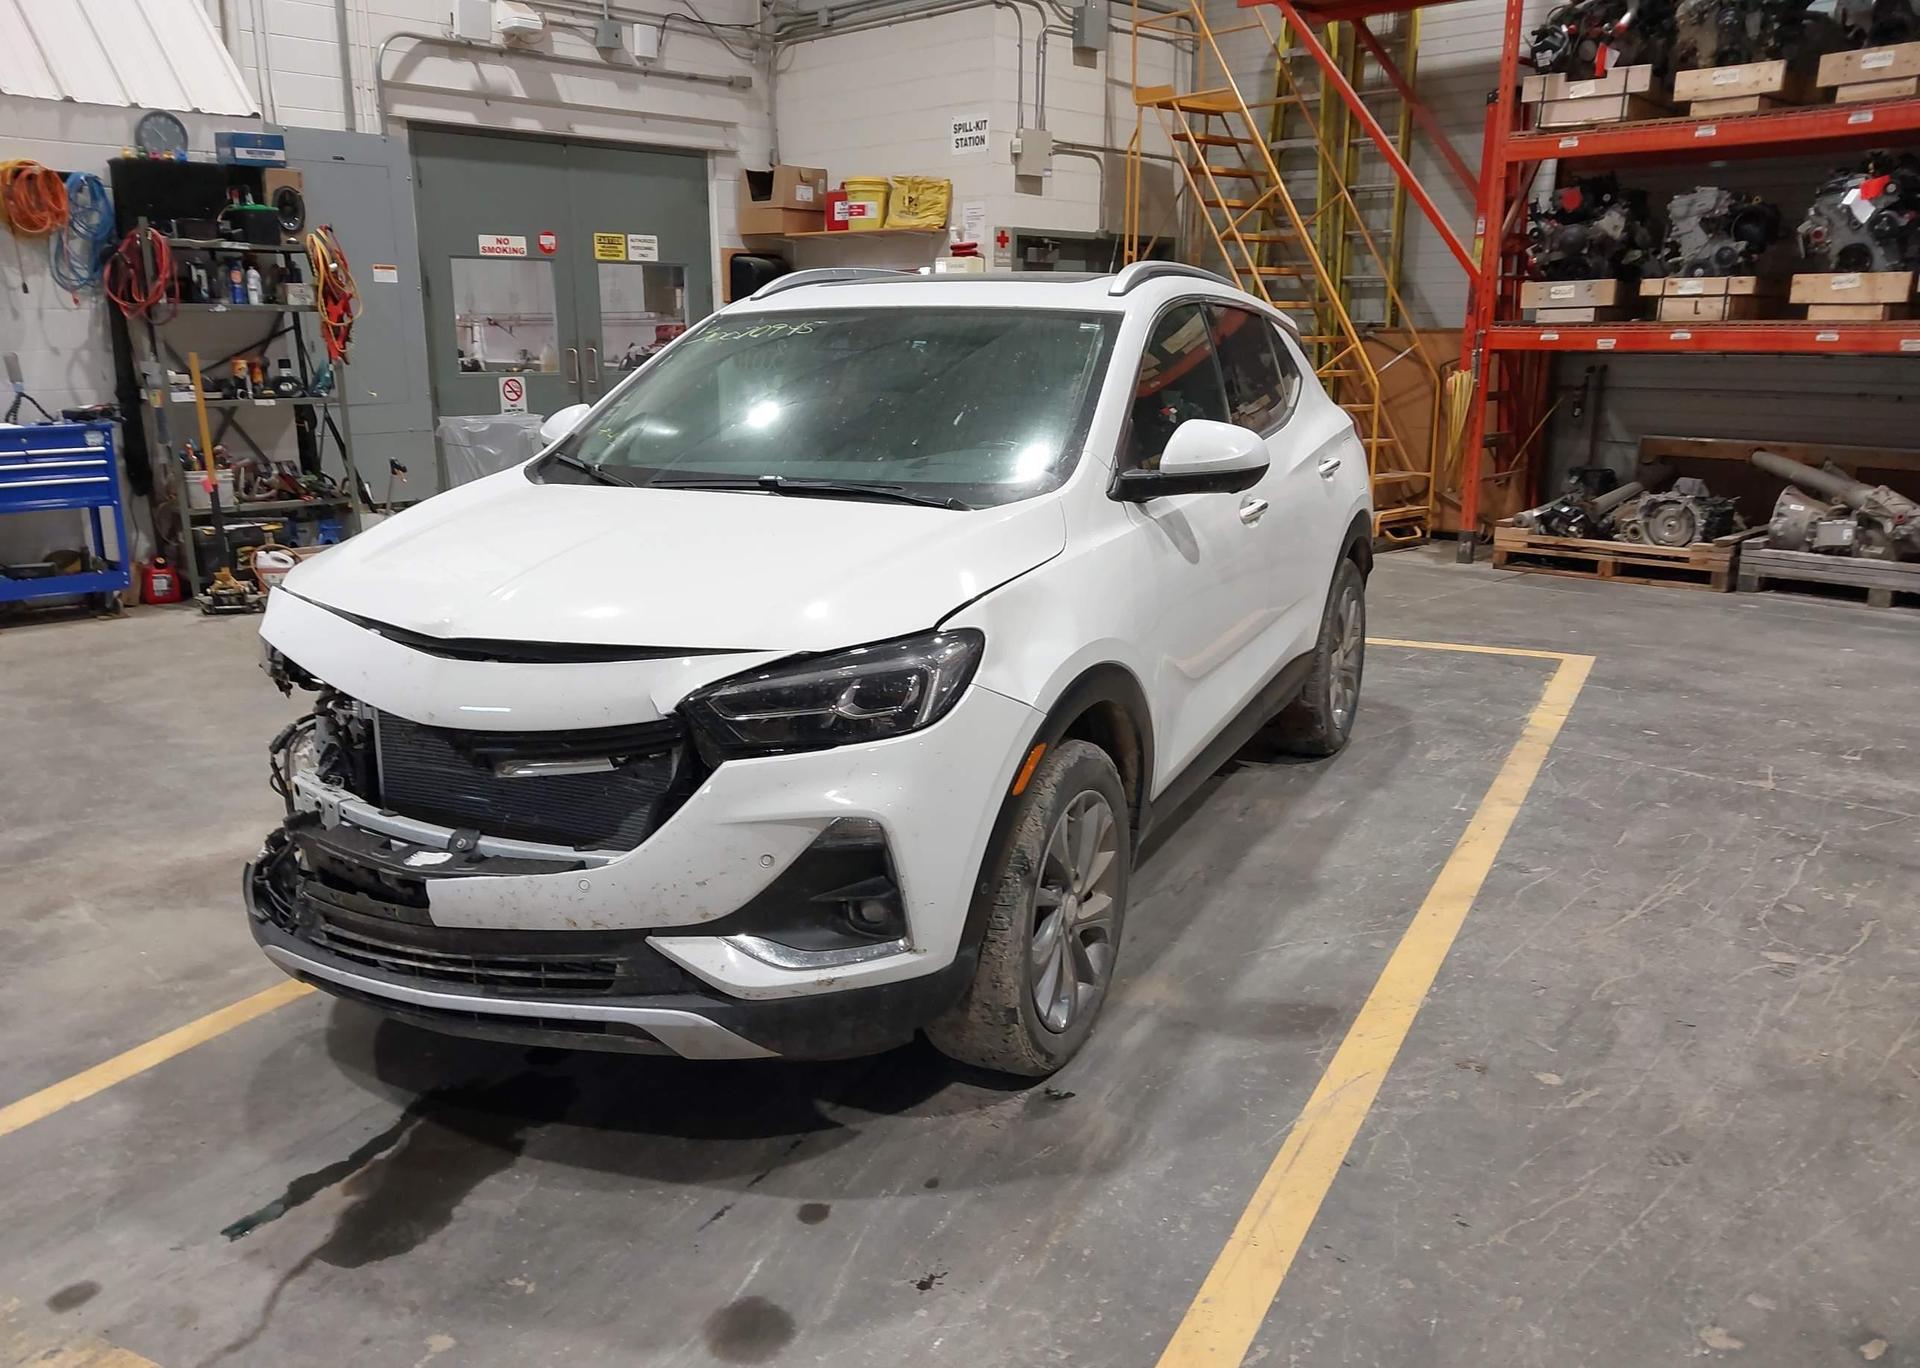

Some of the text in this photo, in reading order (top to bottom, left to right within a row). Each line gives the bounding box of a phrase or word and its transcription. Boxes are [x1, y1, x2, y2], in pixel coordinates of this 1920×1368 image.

[953, 120, 988, 134] SPILL-KIT
[955, 135, 986, 149] STATION
[495, 237, 510, 245] NO
[481, 246, 525, 255] SMOKING
